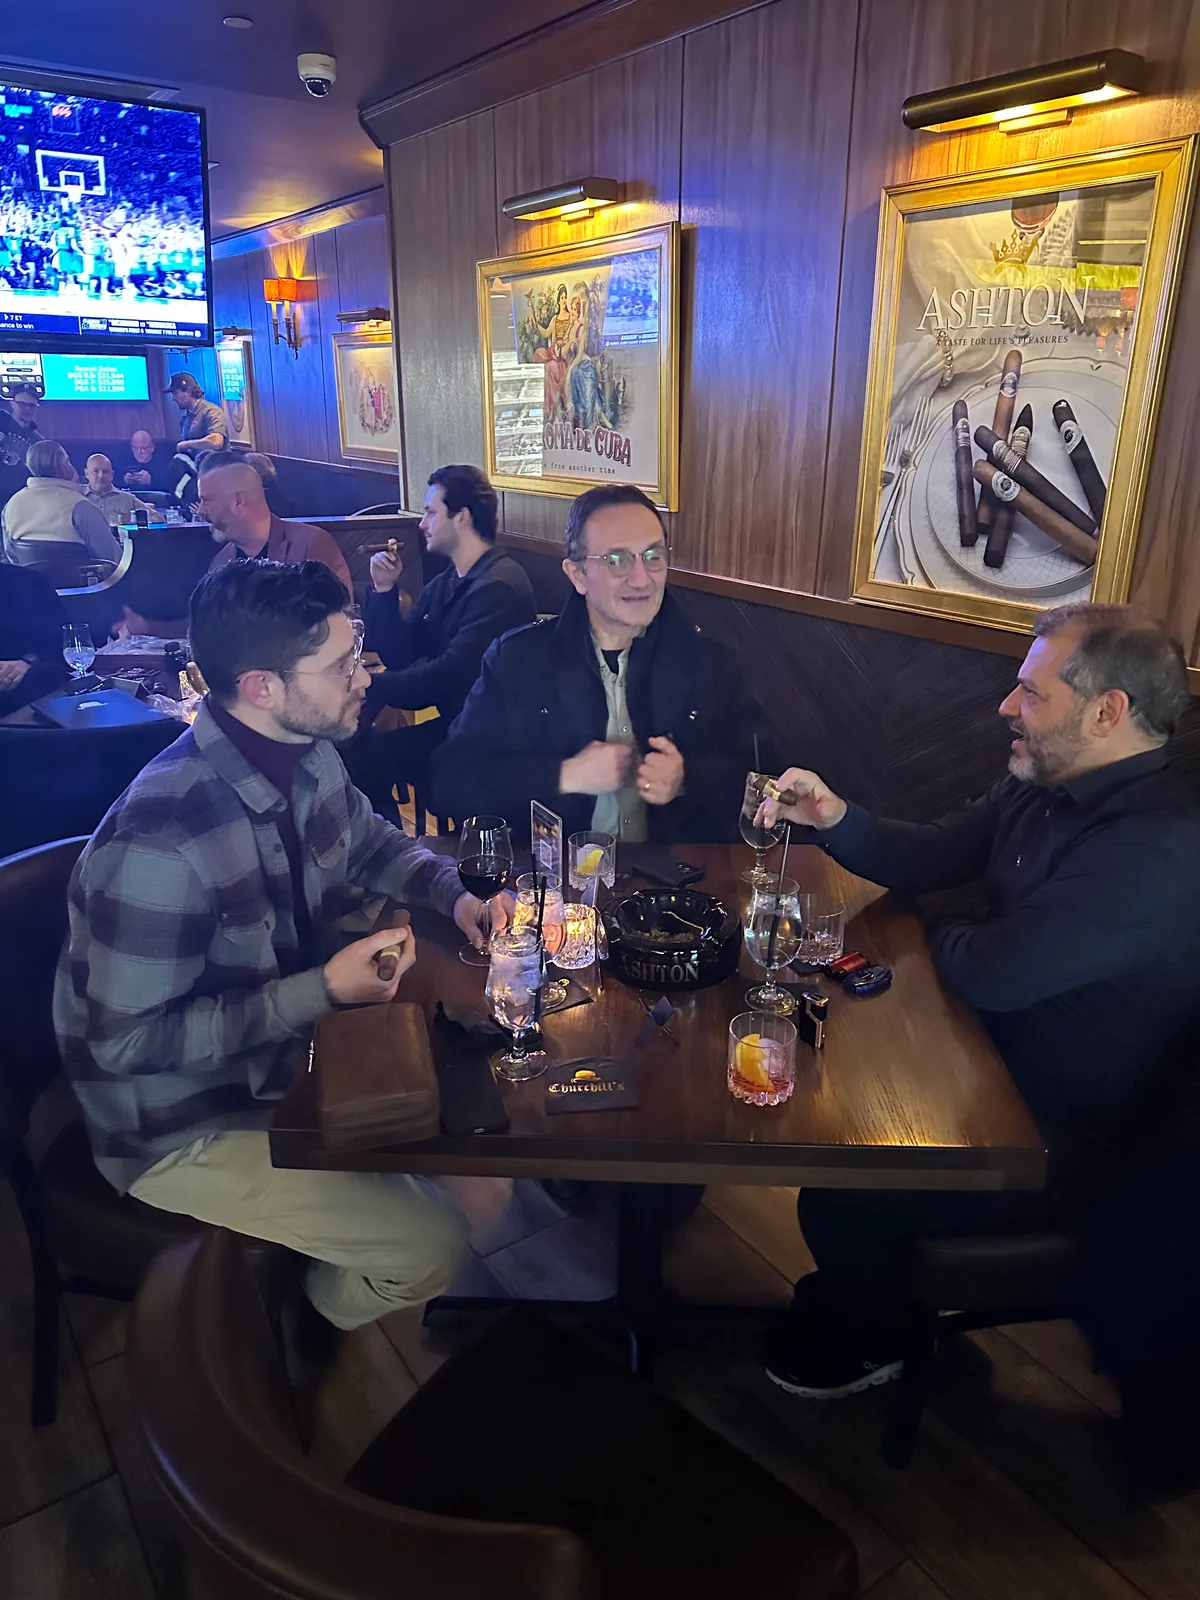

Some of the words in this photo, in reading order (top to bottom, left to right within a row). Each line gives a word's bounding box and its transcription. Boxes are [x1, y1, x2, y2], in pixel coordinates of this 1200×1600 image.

[915, 275, 1095, 331] ASHTON
[971, 338, 986, 346] FOR
[989, 336, 1015, 346] LIFE'S
[1018, 335, 1069, 345] PLEASURES
[576, 427, 592, 453] DE
[594, 426, 632, 468] CUBA
[551, 462, 565, 470] from
[569, 464, 595, 473] another
[600, 467, 616, 475] time
[548, 1081, 625, 1094] Churchill's
